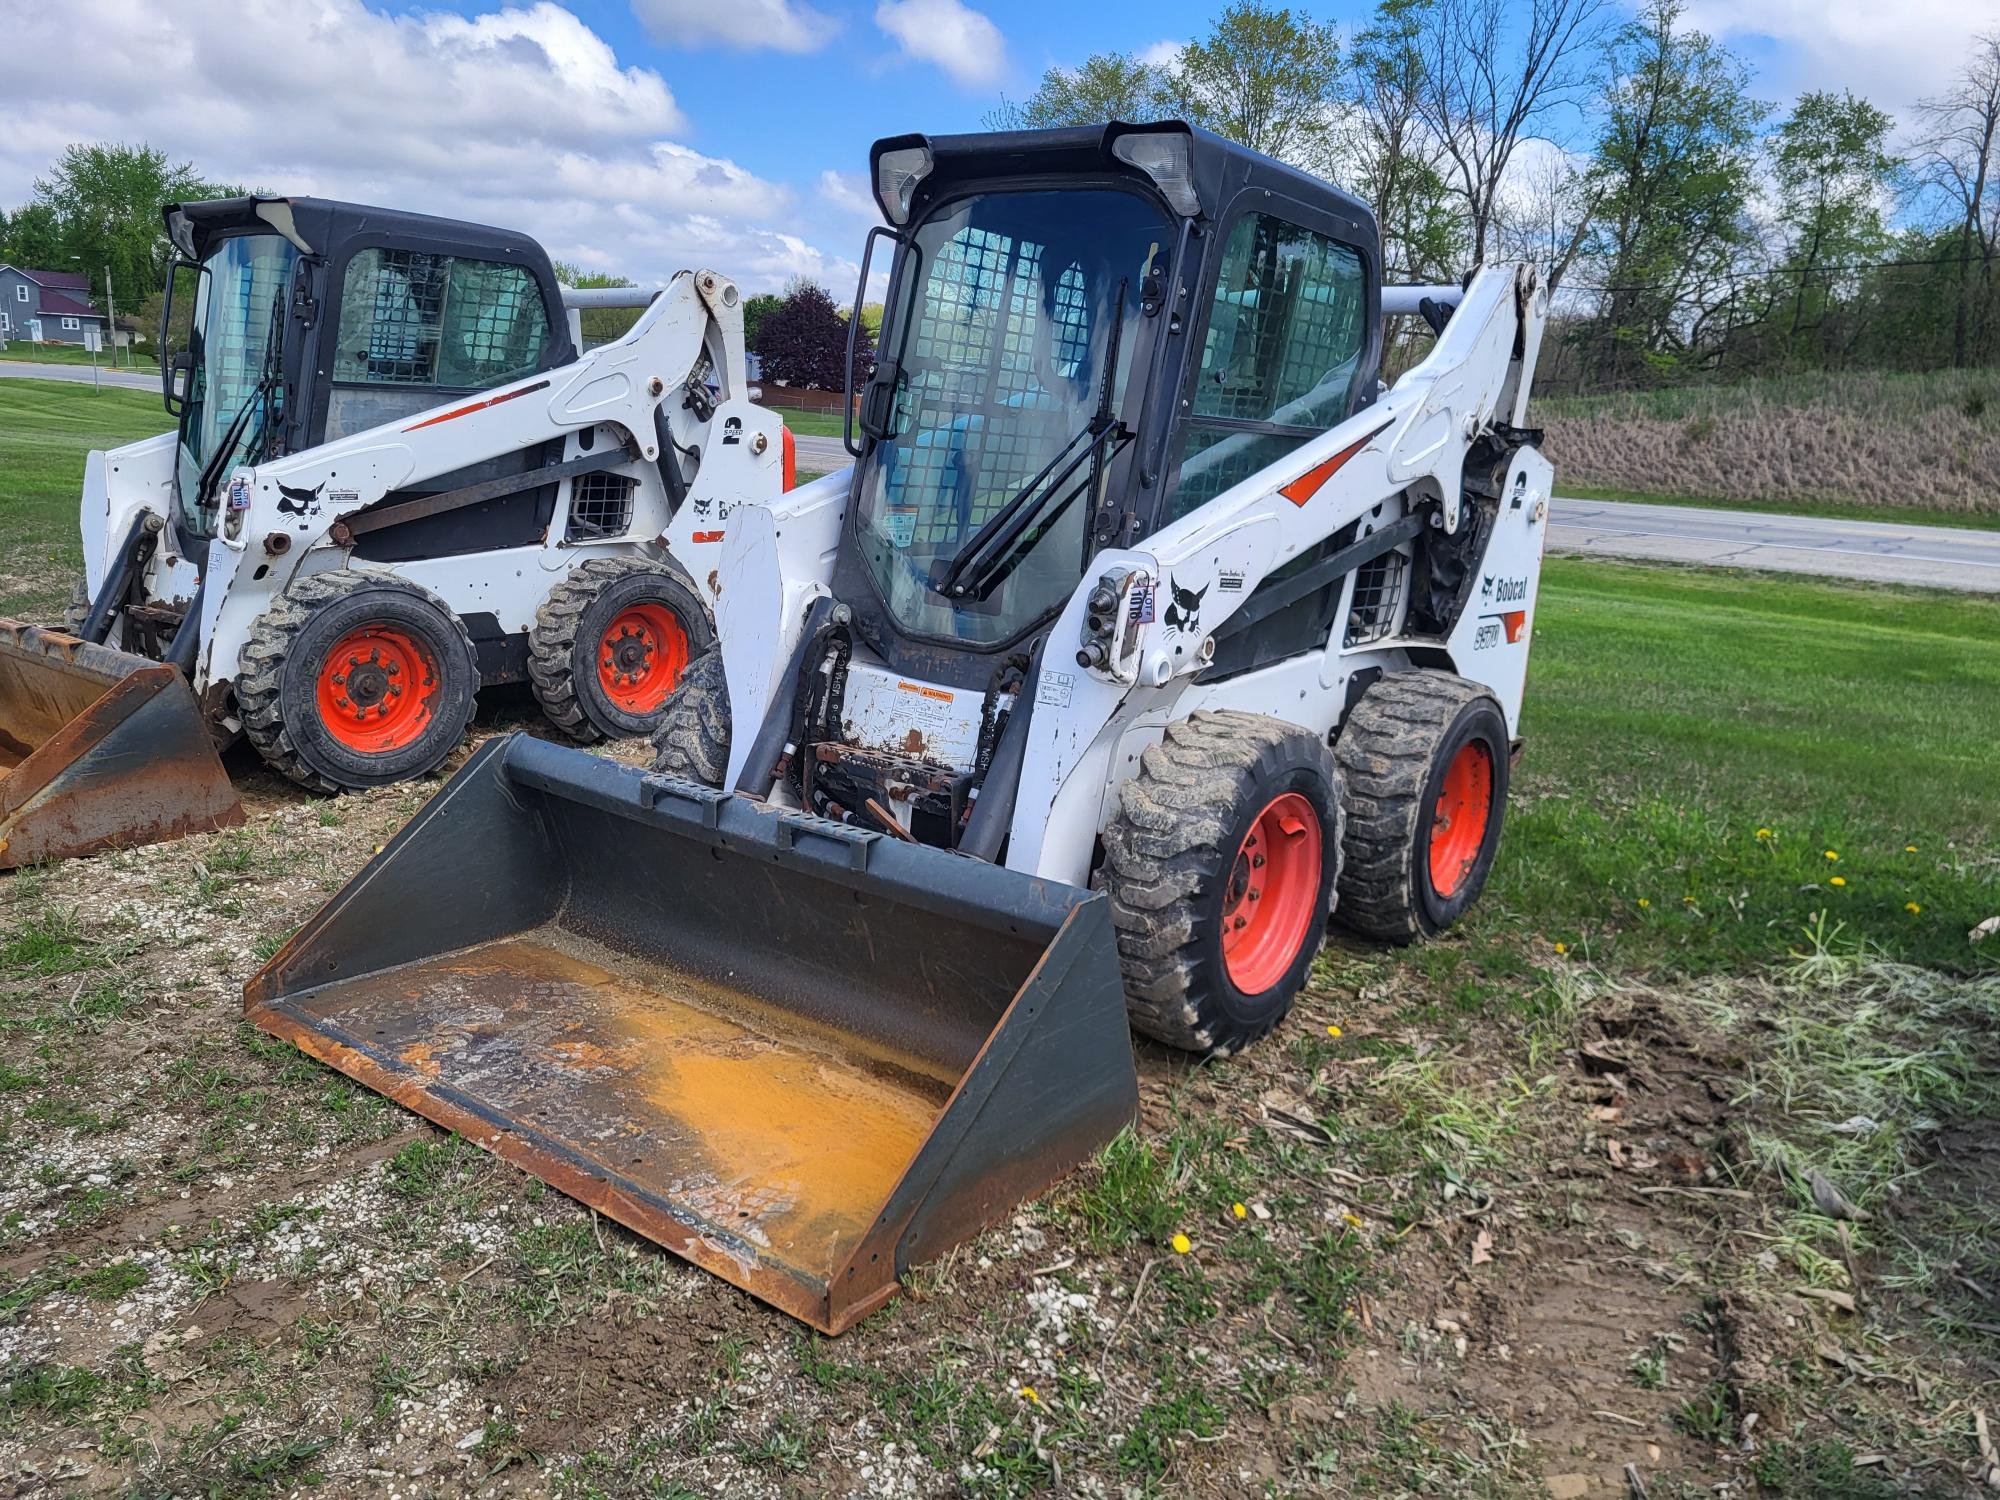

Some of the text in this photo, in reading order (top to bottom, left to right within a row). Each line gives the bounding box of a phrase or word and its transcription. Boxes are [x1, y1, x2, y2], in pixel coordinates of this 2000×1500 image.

[1145, 592, 1153, 609] LOT
[1496, 576, 1528, 603] Bobcat
[1474, 624, 1500, 651] S570
[831, 671, 846, 698] MSHA
